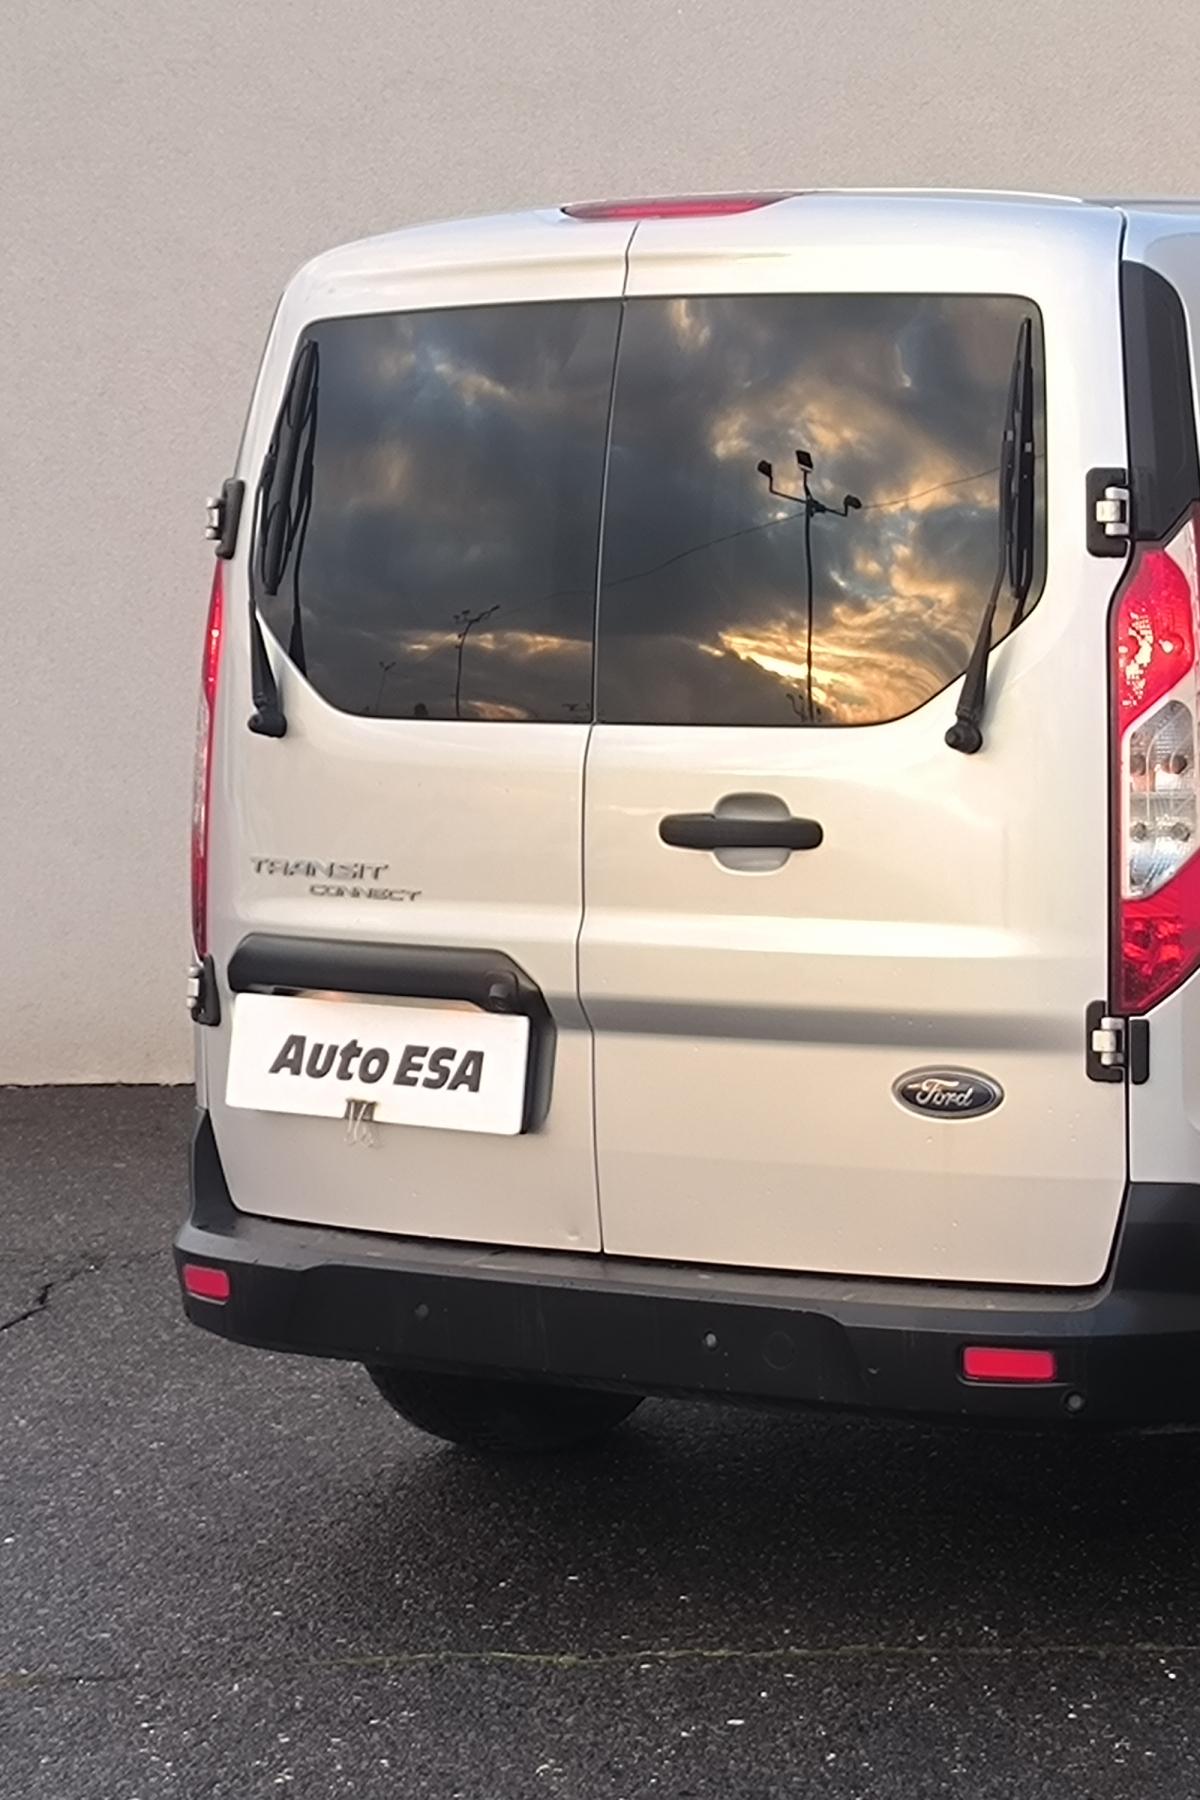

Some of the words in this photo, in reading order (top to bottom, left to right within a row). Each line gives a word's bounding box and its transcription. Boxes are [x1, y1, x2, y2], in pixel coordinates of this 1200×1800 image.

[251, 857, 388, 880] TRANSIT
[309, 883, 422, 902] CONNECT
[269, 1034, 390, 1084] Auto
[393, 1044, 485, 1093] ESA
[907, 1079, 974, 1106] Ford
